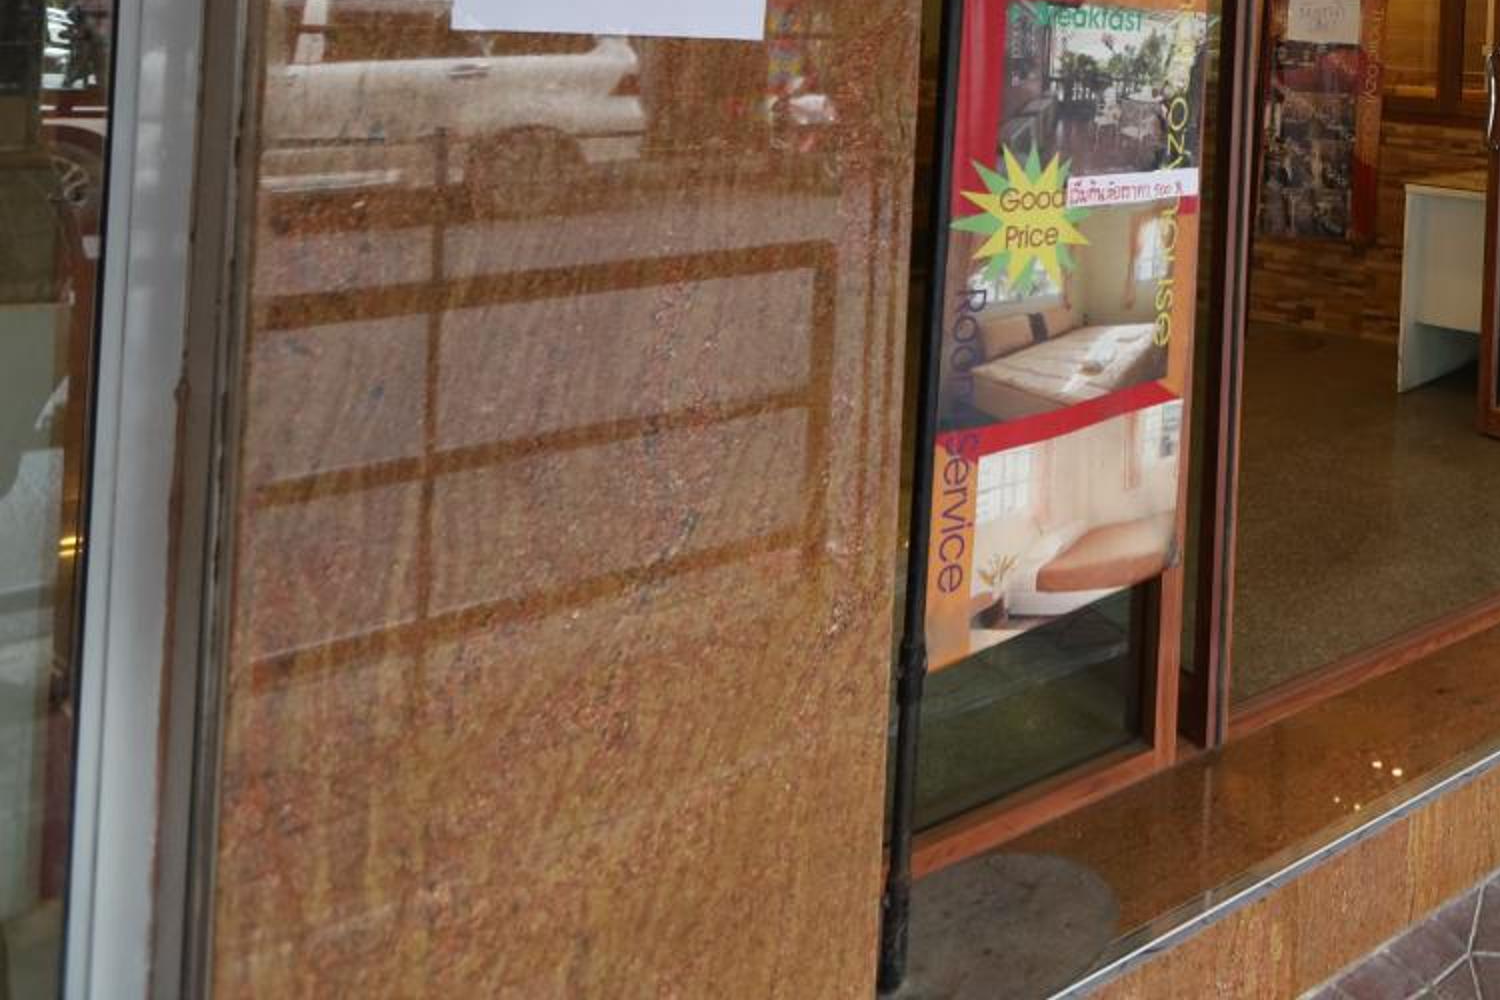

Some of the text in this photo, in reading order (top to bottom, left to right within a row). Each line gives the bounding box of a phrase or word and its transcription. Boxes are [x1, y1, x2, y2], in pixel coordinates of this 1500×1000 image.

[999, 187, 1065, 212] Good
[1004, 225, 1059, 250] Price
[937, 432, 980, 594] Service
